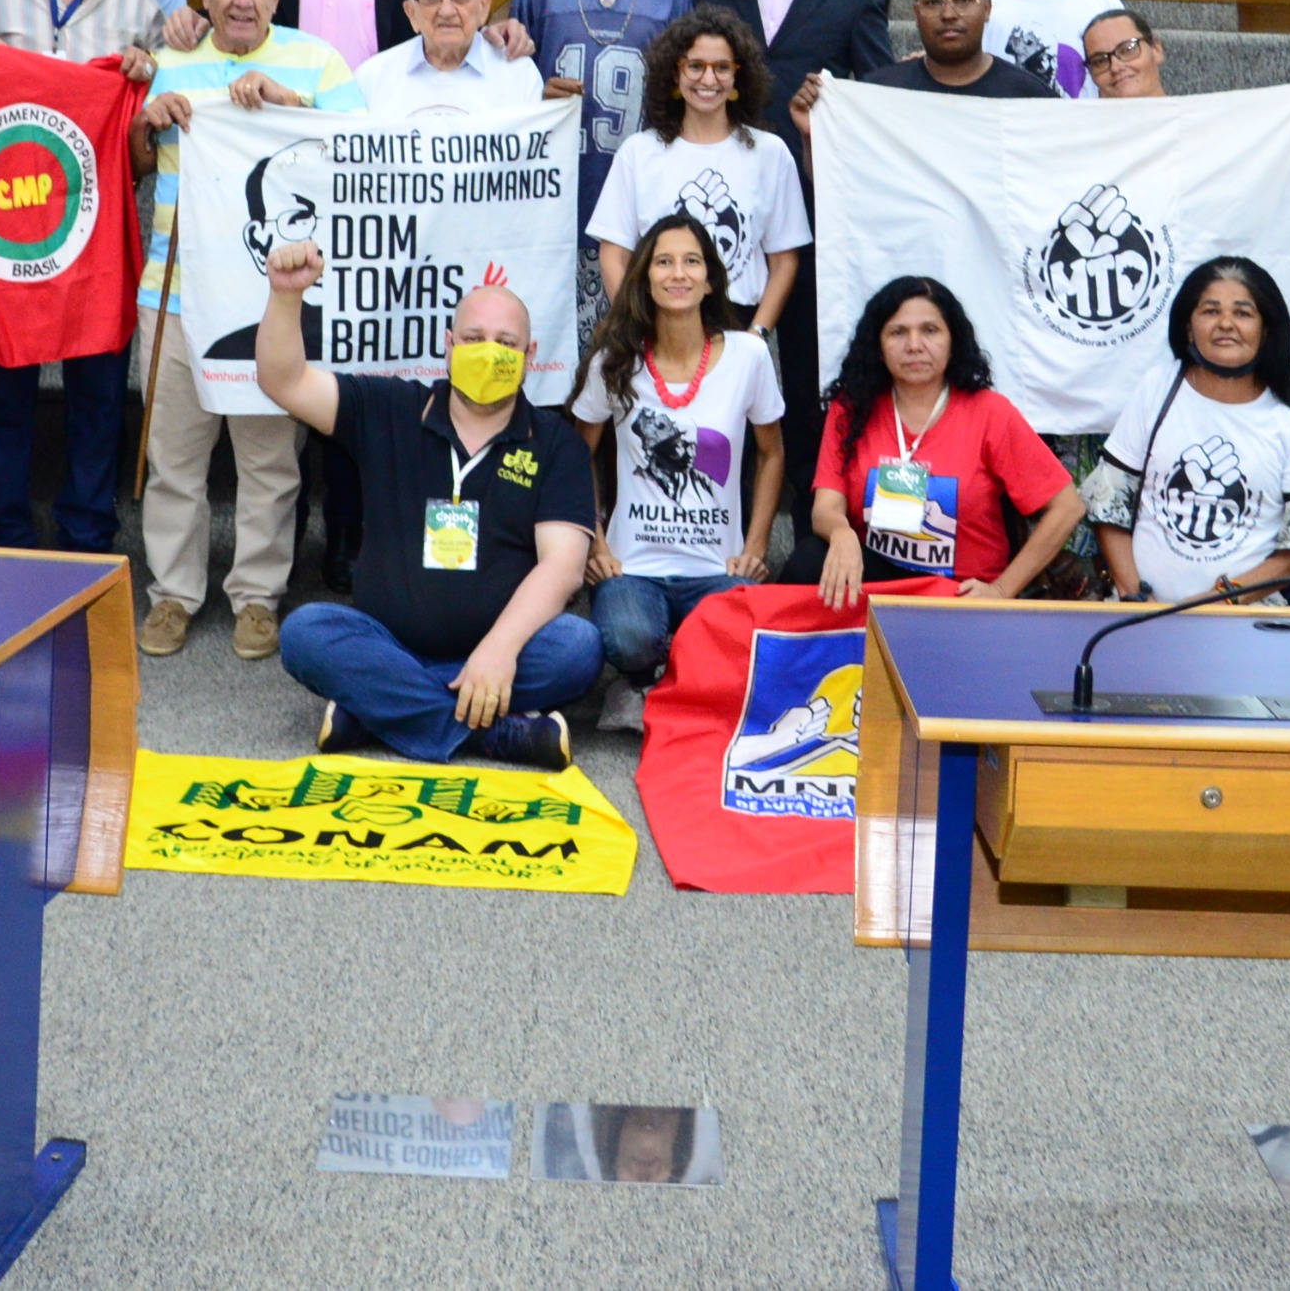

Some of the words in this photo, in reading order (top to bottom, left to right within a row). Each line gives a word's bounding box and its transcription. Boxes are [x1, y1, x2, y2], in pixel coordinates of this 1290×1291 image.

[333, 129, 422, 164] COMITÊ
[431, 135, 521, 164] GOIANO
[526, 130, 553, 161] DE
[66, 130, 93, 213] POPULARES
[333, 172, 445, 204] DIREITOS
[453, 168, 561, 204] HUMANOS
[332, 215, 418, 260] DOM
[12, 258, 61, 278] BRASIL
[332, 253, 464, 312] TOMÁS
[1049, 250, 1150, 318] MTD
[1032, 301, 1043, 314] de
[1041, 314, 1108, 348] Trabalhadoras
[1110, 339, 1117, 347] e
[1120, 286, 1172, 344] Trabalhadores
[331, 316, 453, 364] BALDU
[202, 369, 249, 383] Nenhum
[497, 467, 532, 489] CONAM
[628, 503, 730, 526] MULHERES
[644, 524, 658, 533] EM
[662, 525, 689, 535] LUTA
[635, 534, 675, 545] DIREITO
[869, 531, 951, 564] MNLM
[735, 774, 855, 797] MN
[735, 799, 758, 811] DE
[762, 800, 807, 814] LUTA
[152, 818, 581, 860] CONAM
